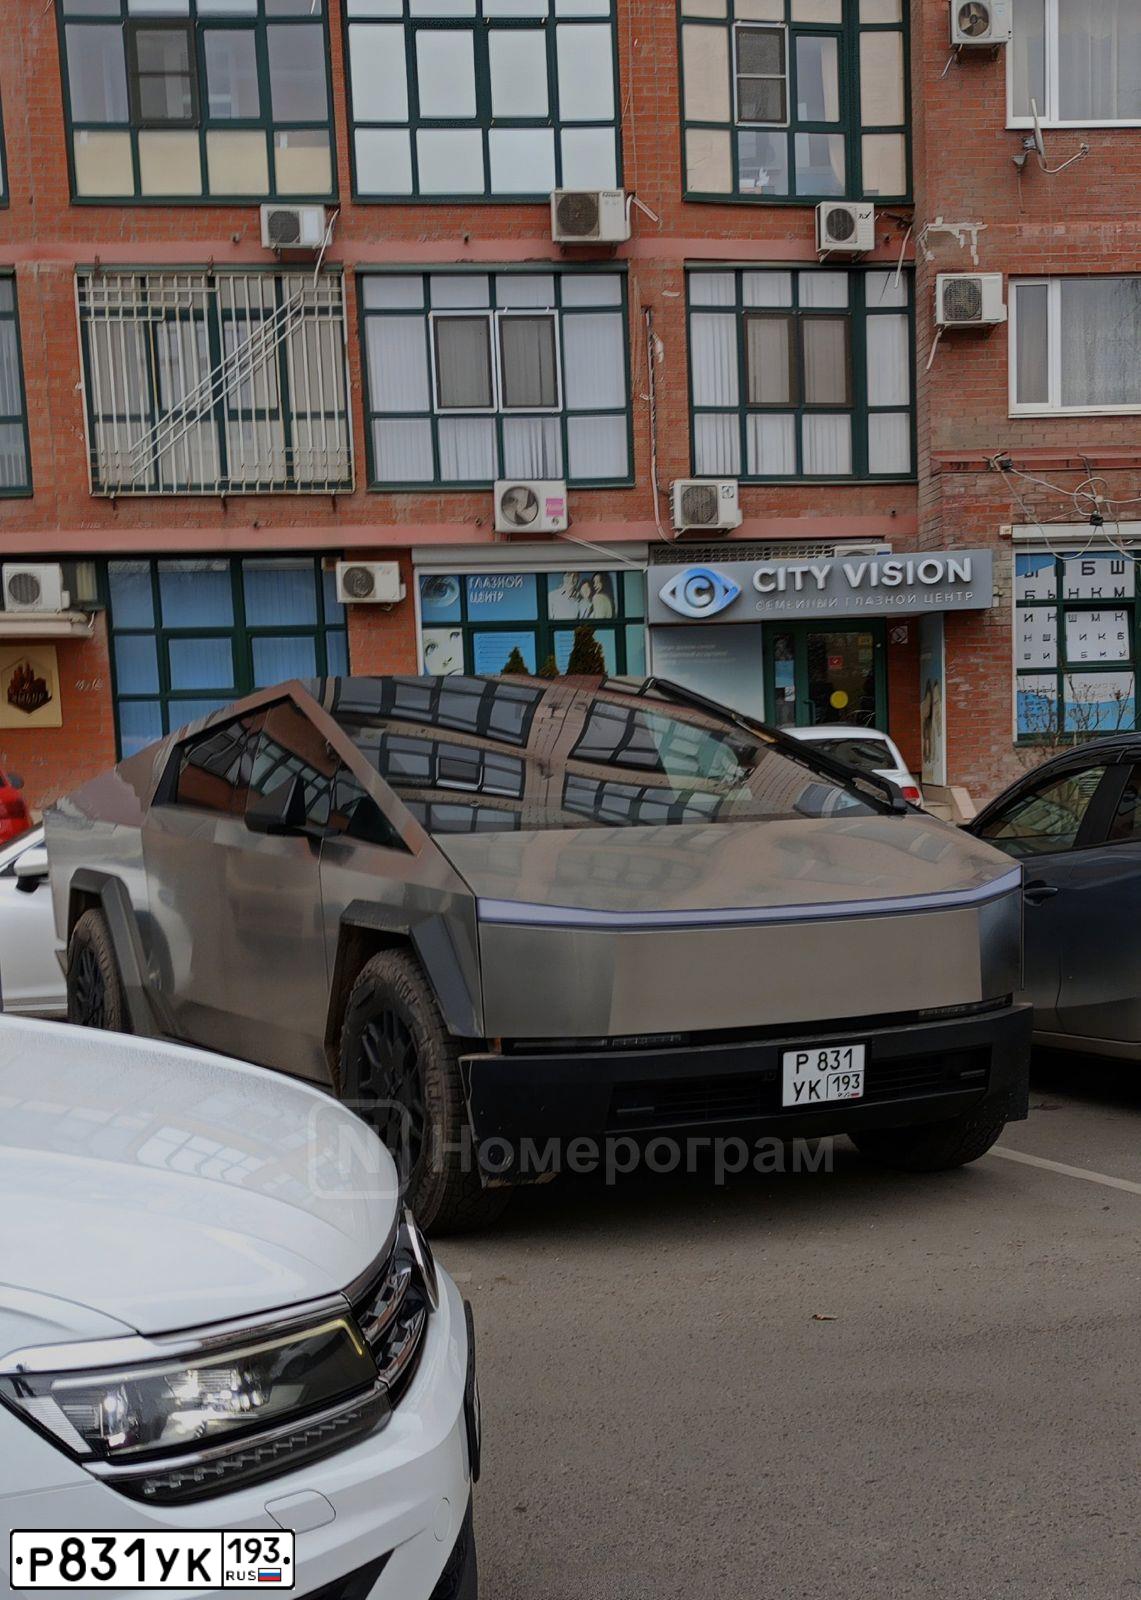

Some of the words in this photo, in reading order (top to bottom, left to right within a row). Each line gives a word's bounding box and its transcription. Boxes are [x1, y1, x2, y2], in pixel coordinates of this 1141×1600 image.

[752, 564, 833, 594] CITY
[843, 557, 973, 588] VISION
[924, 591, 975, 605] ЦЕНТР
[793, 1079, 822, 1102] УК
[832, 1073, 861, 1092] 193
